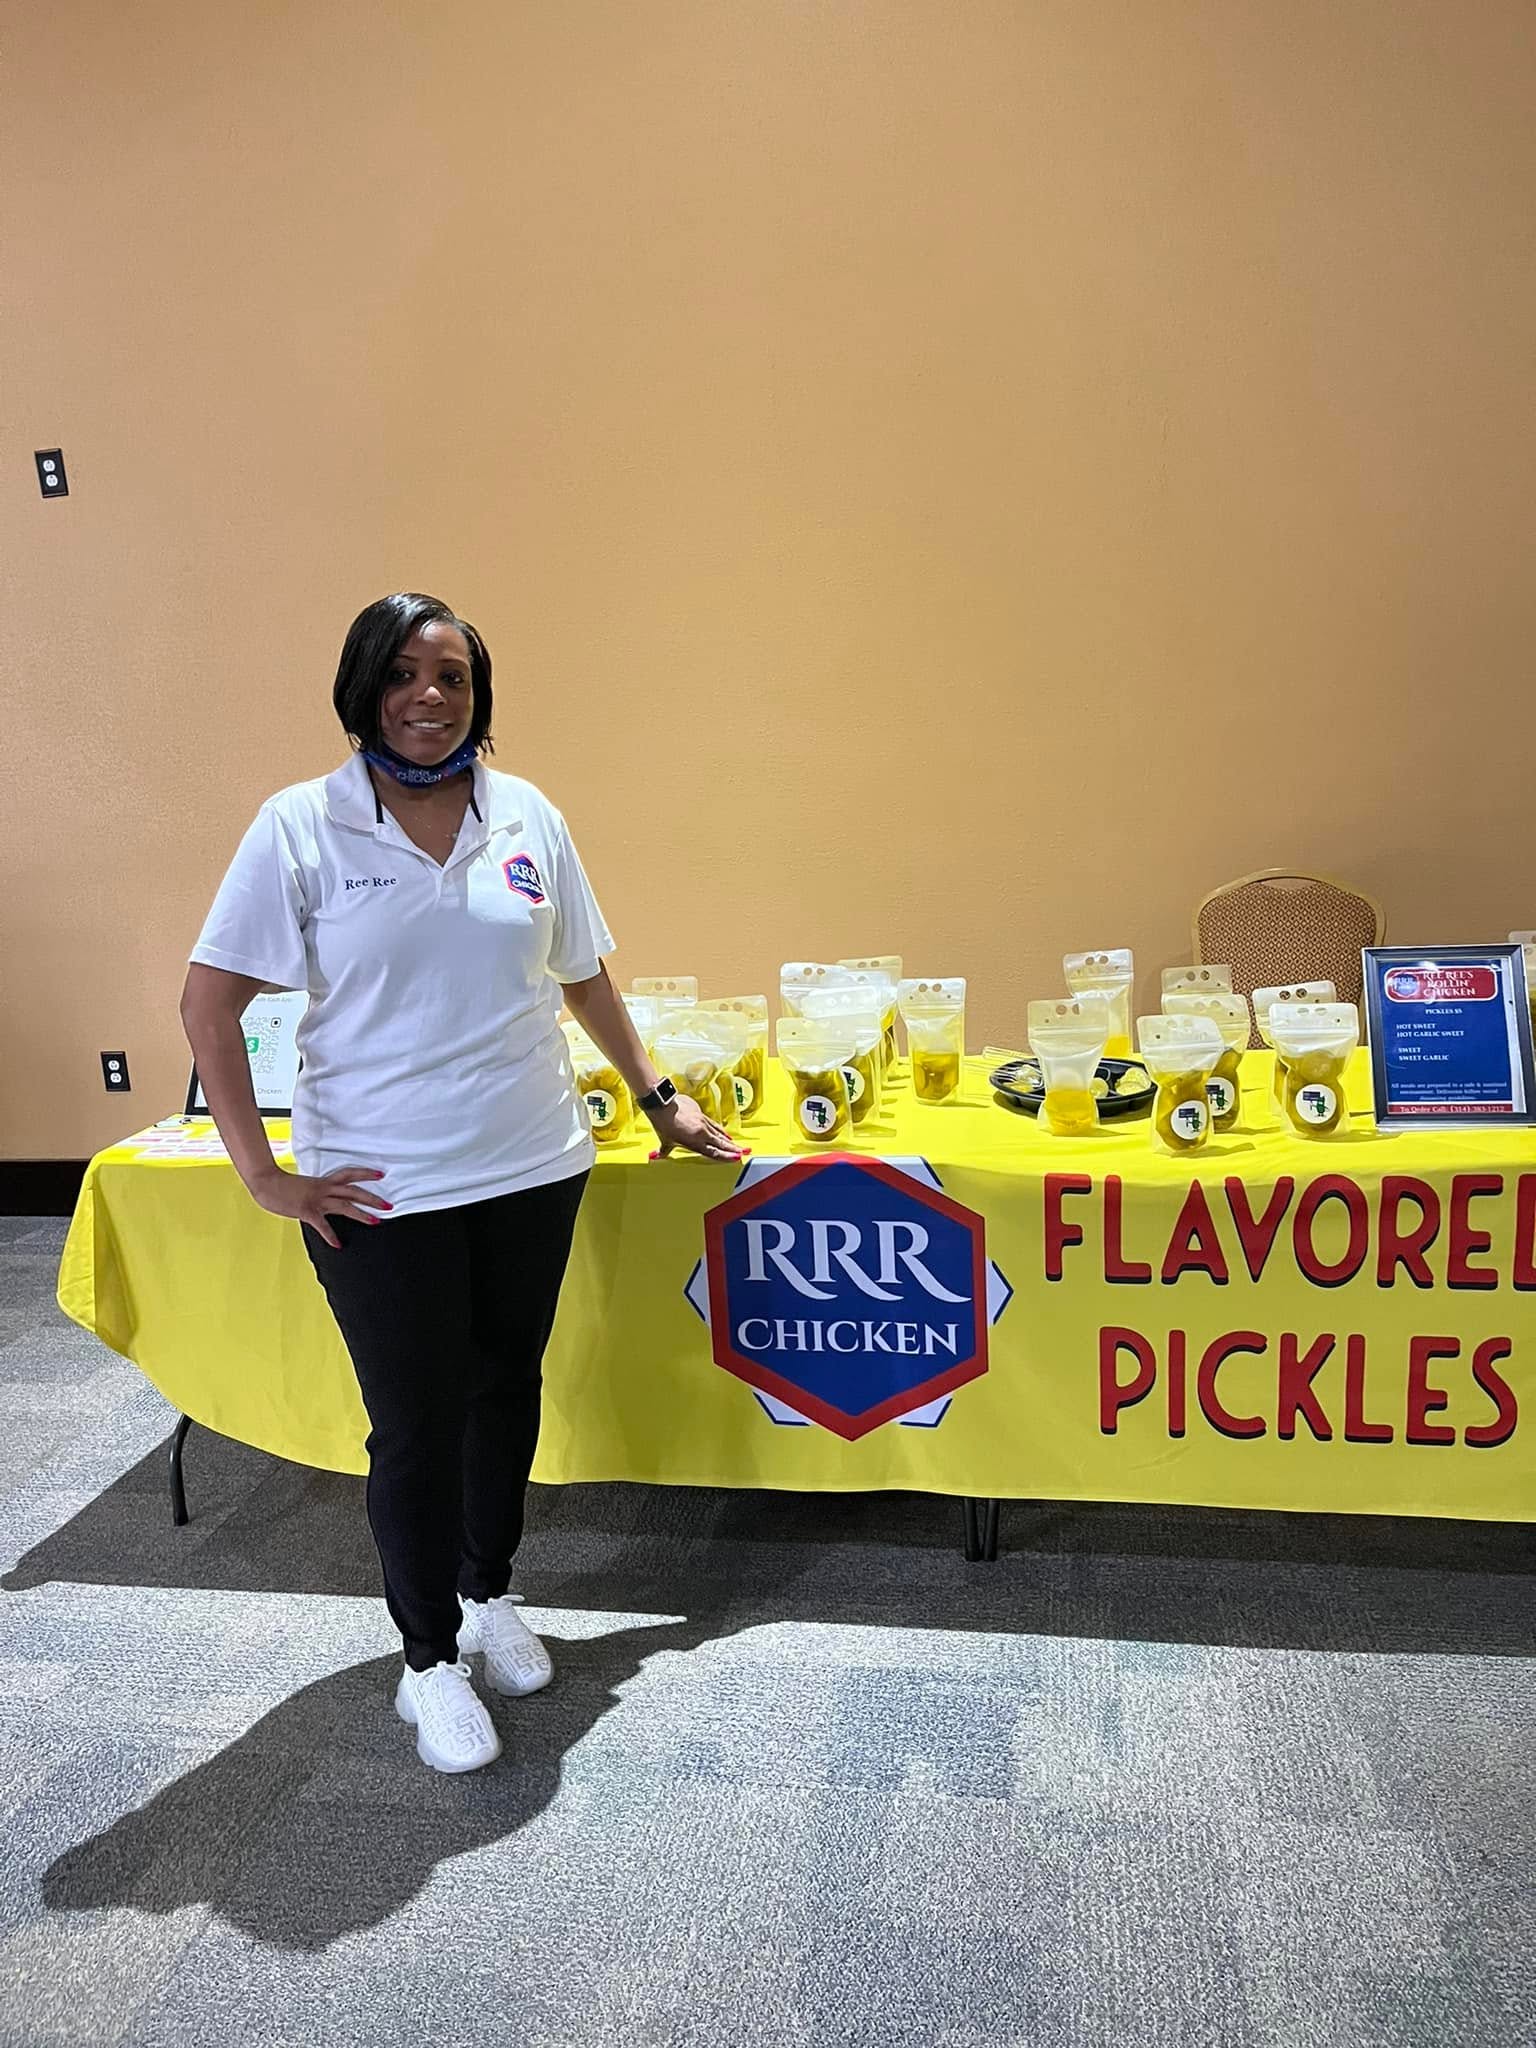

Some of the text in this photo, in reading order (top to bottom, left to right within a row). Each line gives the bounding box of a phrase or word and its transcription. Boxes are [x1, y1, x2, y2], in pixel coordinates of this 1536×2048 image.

[345, 877, 397, 890] Ree Ree
[508, 863, 542, 887] RRR
[739, 1218, 973, 1303] RRR
[737, 1318, 960, 1356] CHICKEN
[1100, 1325, 1519, 1449] PICKLES
